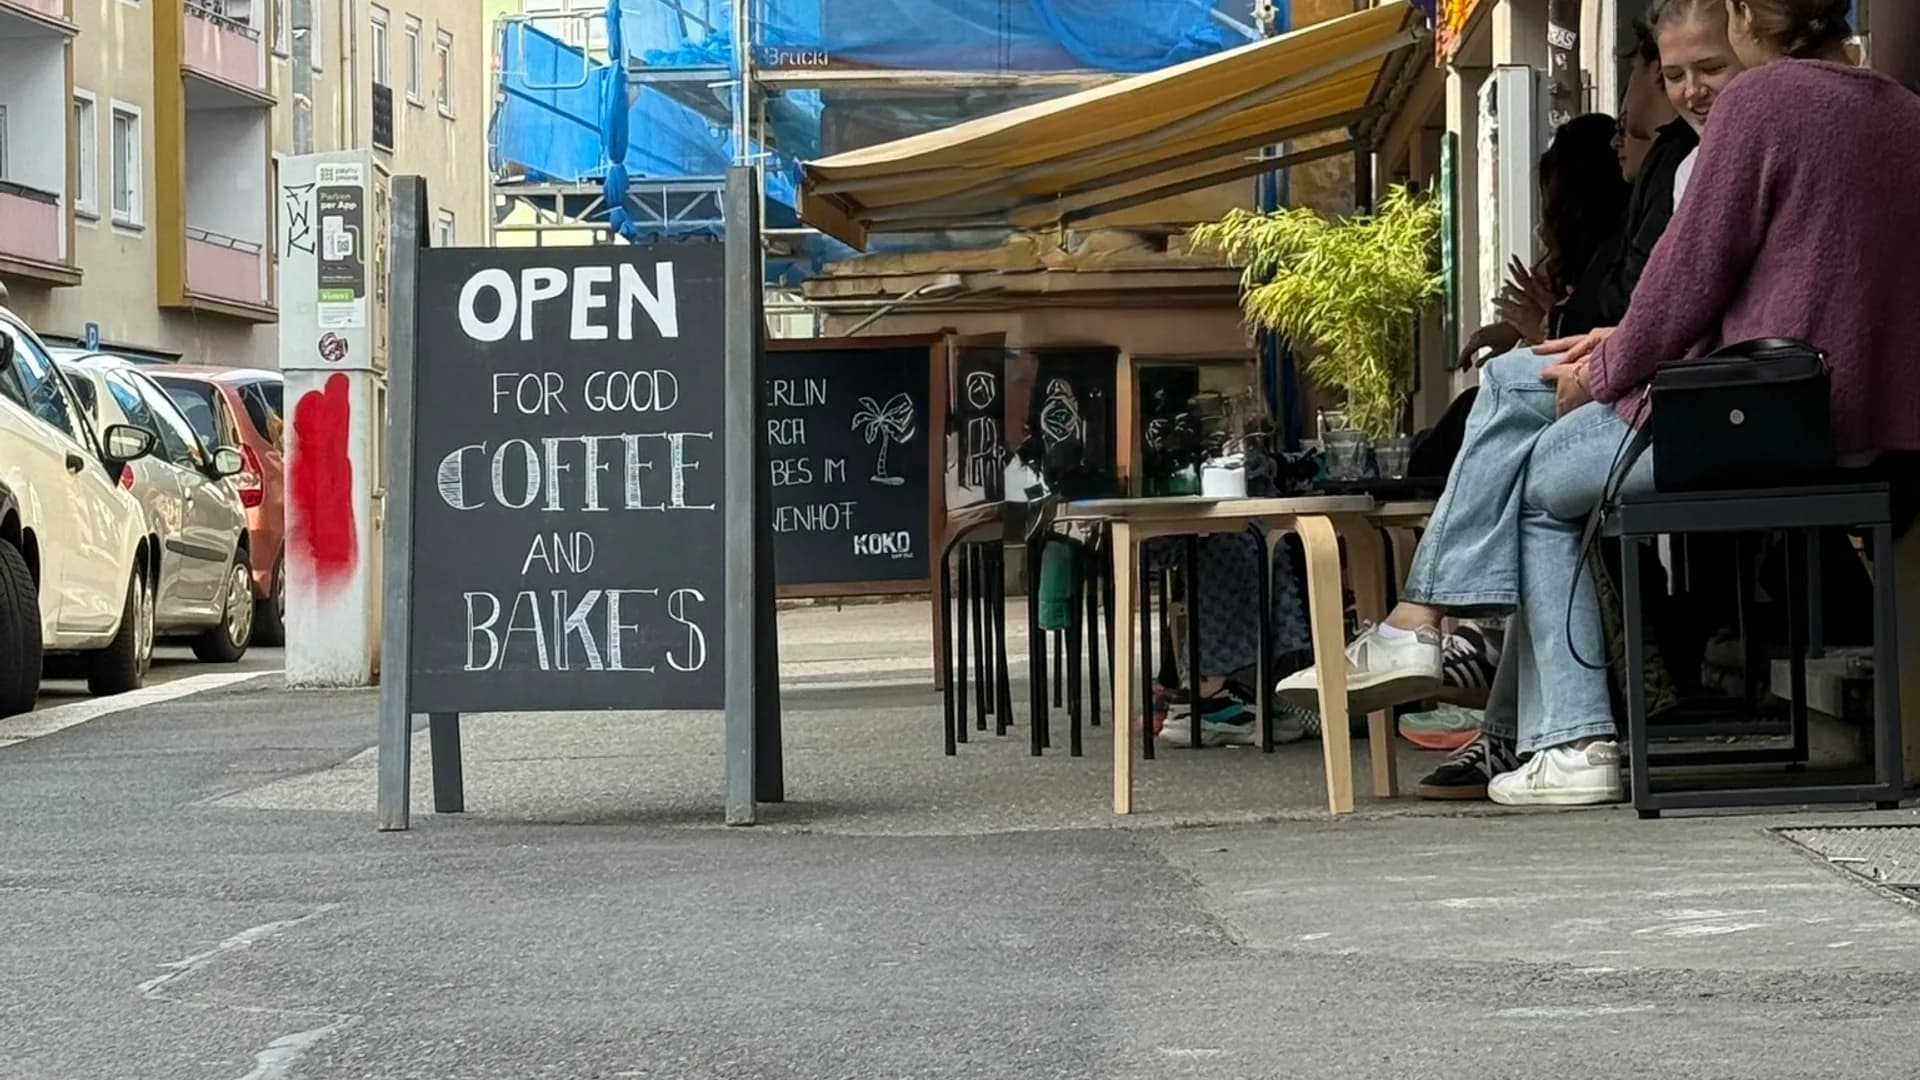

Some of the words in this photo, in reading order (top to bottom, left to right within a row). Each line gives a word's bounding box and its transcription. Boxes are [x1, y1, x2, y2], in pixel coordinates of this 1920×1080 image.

[320, 202, 336, 210] per
[337, 200, 357, 211] App
[458, 261, 679, 342] OPEN
[493, 372, 568, 415] FOR
[584, 369, 679, 412] GOOD
[437, 432, 715, 511] COFFEE
[770, 457, 813, 487] BES
[824, 458, 847, 483] IM
[521, 532, 594, 575] AND
[853, 531, 911, 555] KOKO
[464, 588, 706, 672] BAKES
